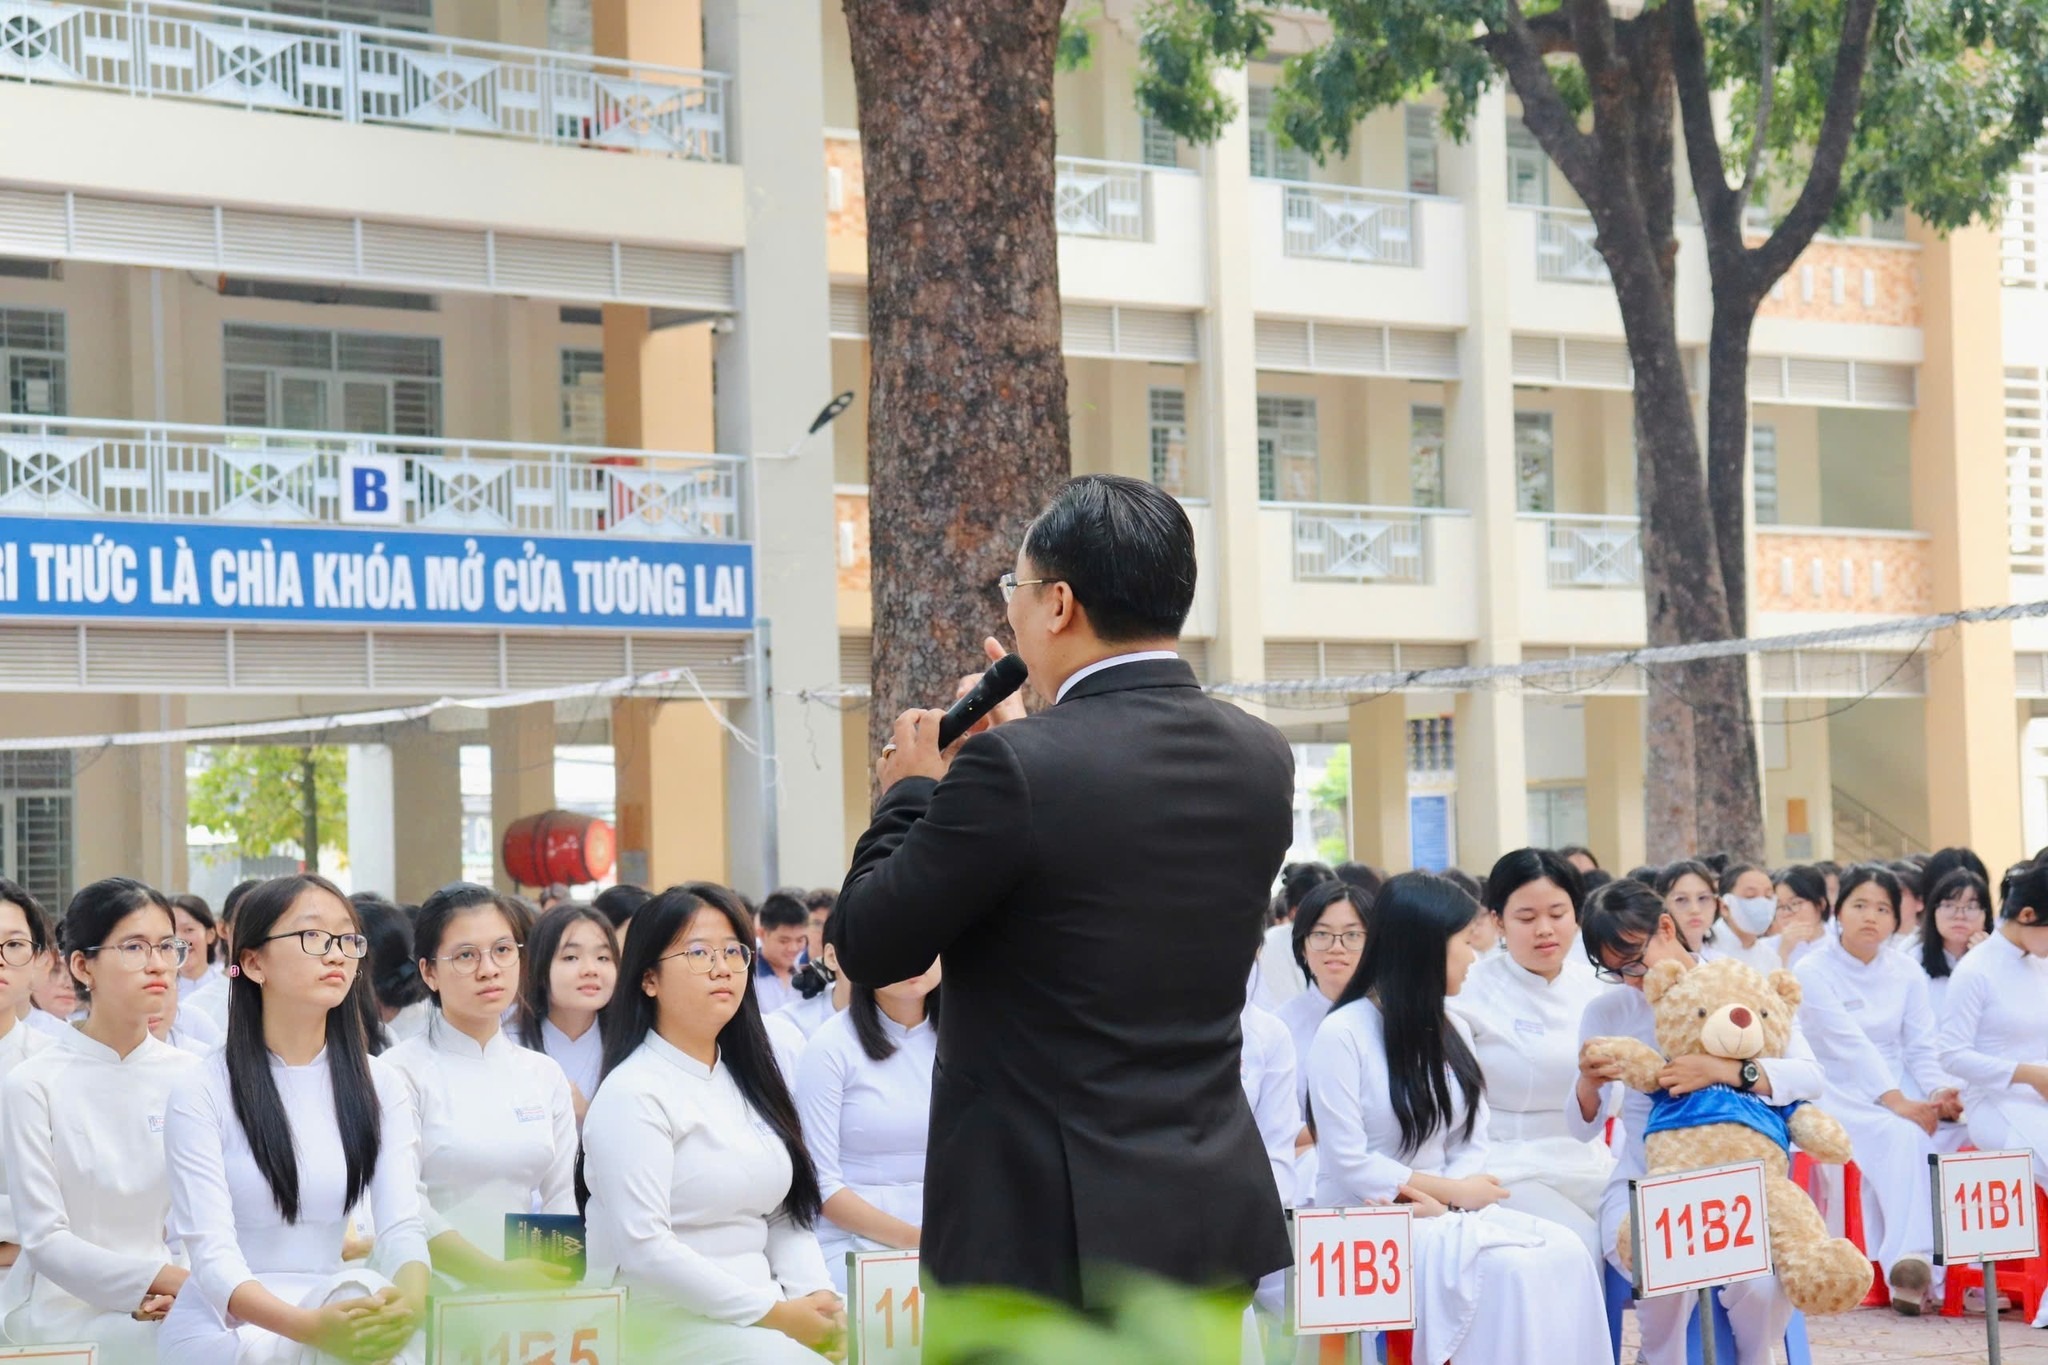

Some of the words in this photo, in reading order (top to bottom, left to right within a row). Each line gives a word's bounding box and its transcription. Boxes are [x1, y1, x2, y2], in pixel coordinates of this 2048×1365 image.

[353, 467, 388, 512] B
[30, 533, 138, 603] THỨC
[150, 536, 200, 605] LÀ
[210, 538, 304, 607] CHÌA
[313, 542, 417, 610] KHÓA
[424, 538, 485, 612] MỞ
[493, 540, 567, 613] CỬA
[572, 556, 686, 616] TƯƠNG
[694, 564, 746, 617] LAI
[1655, 1194, 1755, 1260] 11B2
[1954, 1178, 2024, 1231] 11B1
[1310, 1239, 1401, 1298] 11B3
